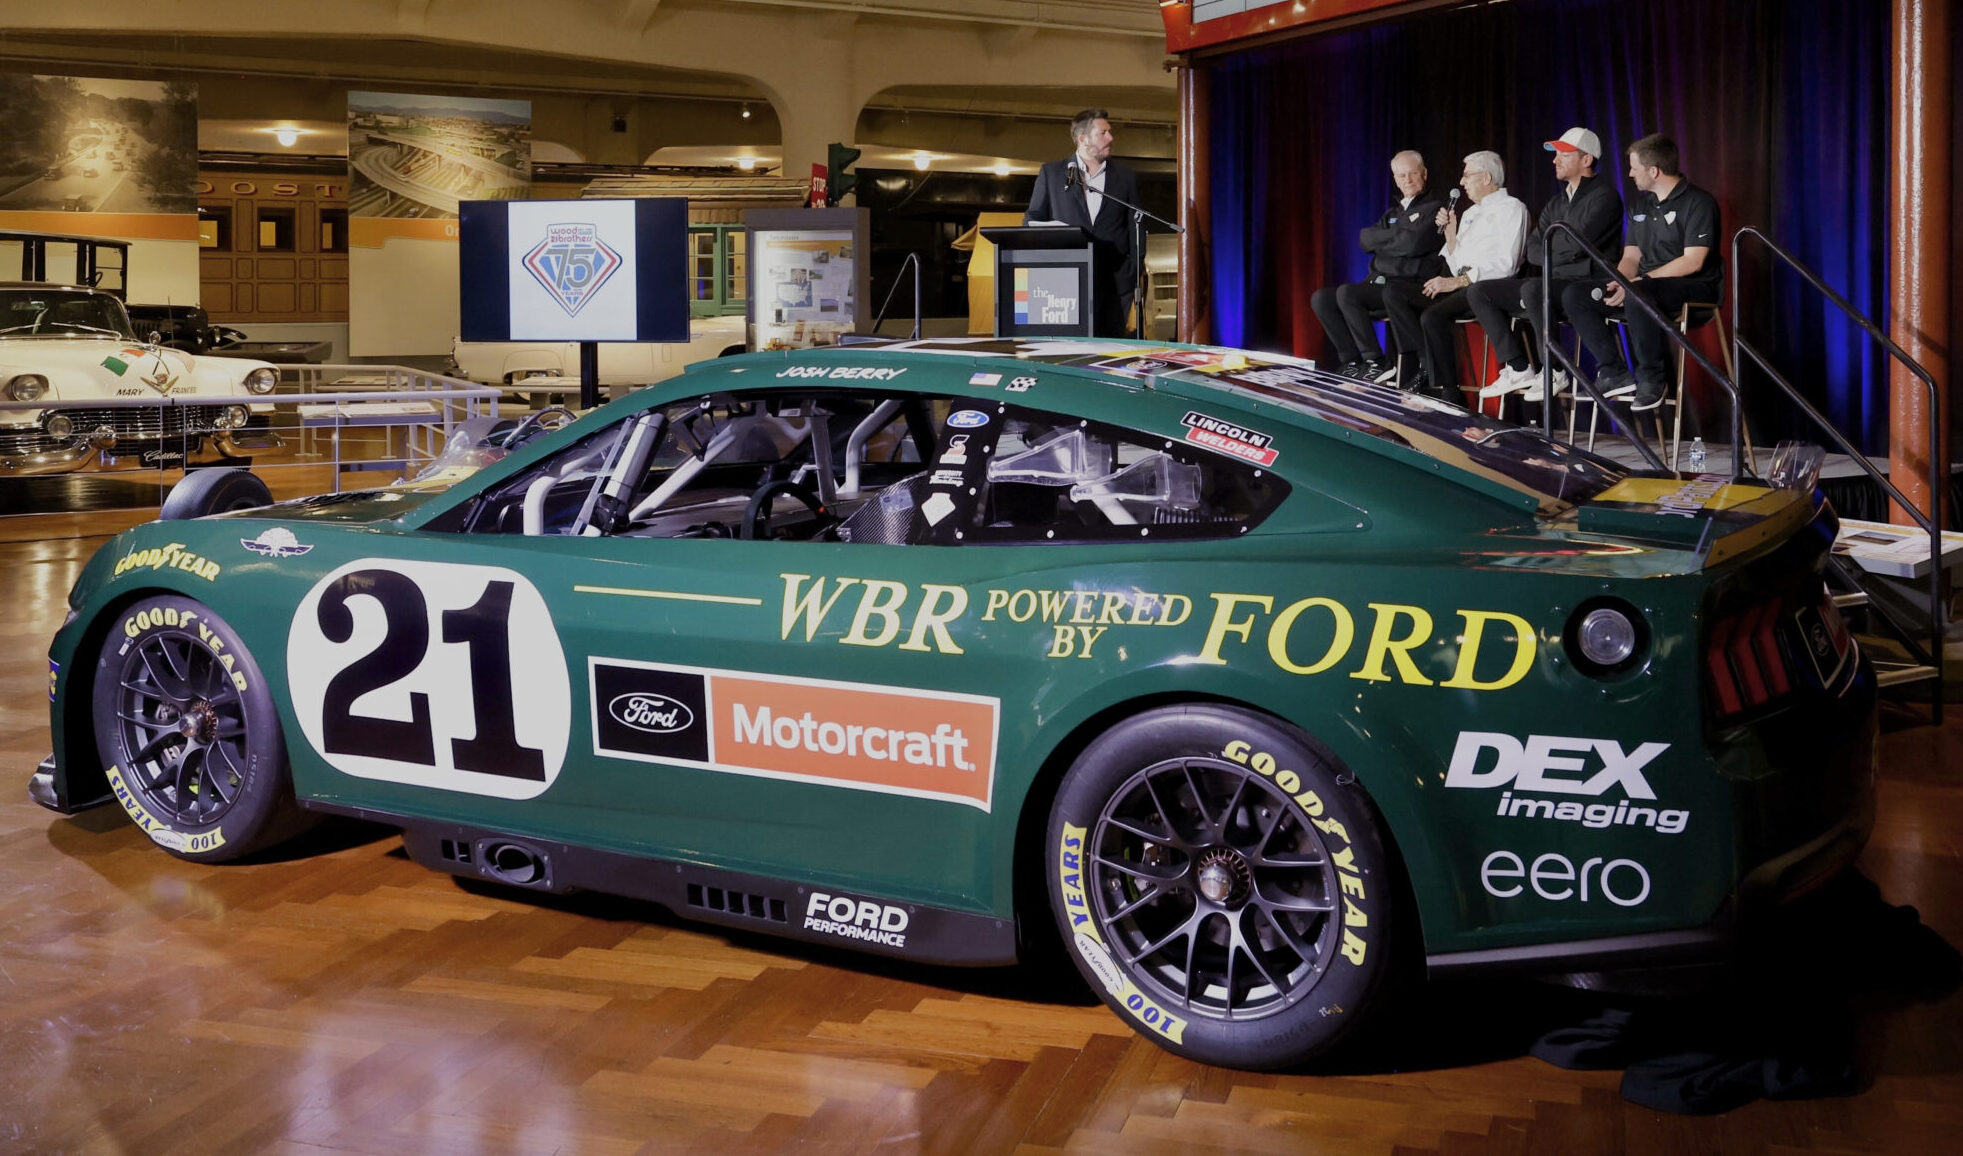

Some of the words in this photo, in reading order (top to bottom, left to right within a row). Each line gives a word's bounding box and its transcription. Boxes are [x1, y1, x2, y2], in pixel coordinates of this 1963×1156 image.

[813, 177, 826, 193] STOP
[551, 227, 577, 235] wood
[545, 248, 597, 289] 75
[1033, 286, 1048, 298] the
[1047, 294, 1077, 310] Henry
[1042, 306, 1068, 323] Ford
[116, 388, 145, 396] MARY
[776, 366, 829, 379] JOSH
[829, 367, 907, 380] BERRY
[1186, 414, 1266, 447] LINCOLN
[1195, 430, 1267, 462] WELDERS
[114, 542, 221, 582] GOODYEAR
[779, 572, 970, 655] WBR
[981, 588, 1193, 626] POWERED
[1048, 625, 1108, 658] BY
[1197, 592, 1538, 691] FORD
[317, 569, 546, 782] 21
[1444, 730, 1672, 800] DEX
[111, 775, 152, 830] YEARS
[1496, 791, 1690, 834] imaging
[190, 832, 218, 850] 100
[1221, 740, 1369, 967] GOODYEAR
[1063, 833, 1089, 928] YEARS
[1480, 850, 1651, 907] eero
[803, 916, 906, 948] PERFORMANCE
[806, 892, 909, 933] FORD
[1126, 993, 1176, 1034] 100
